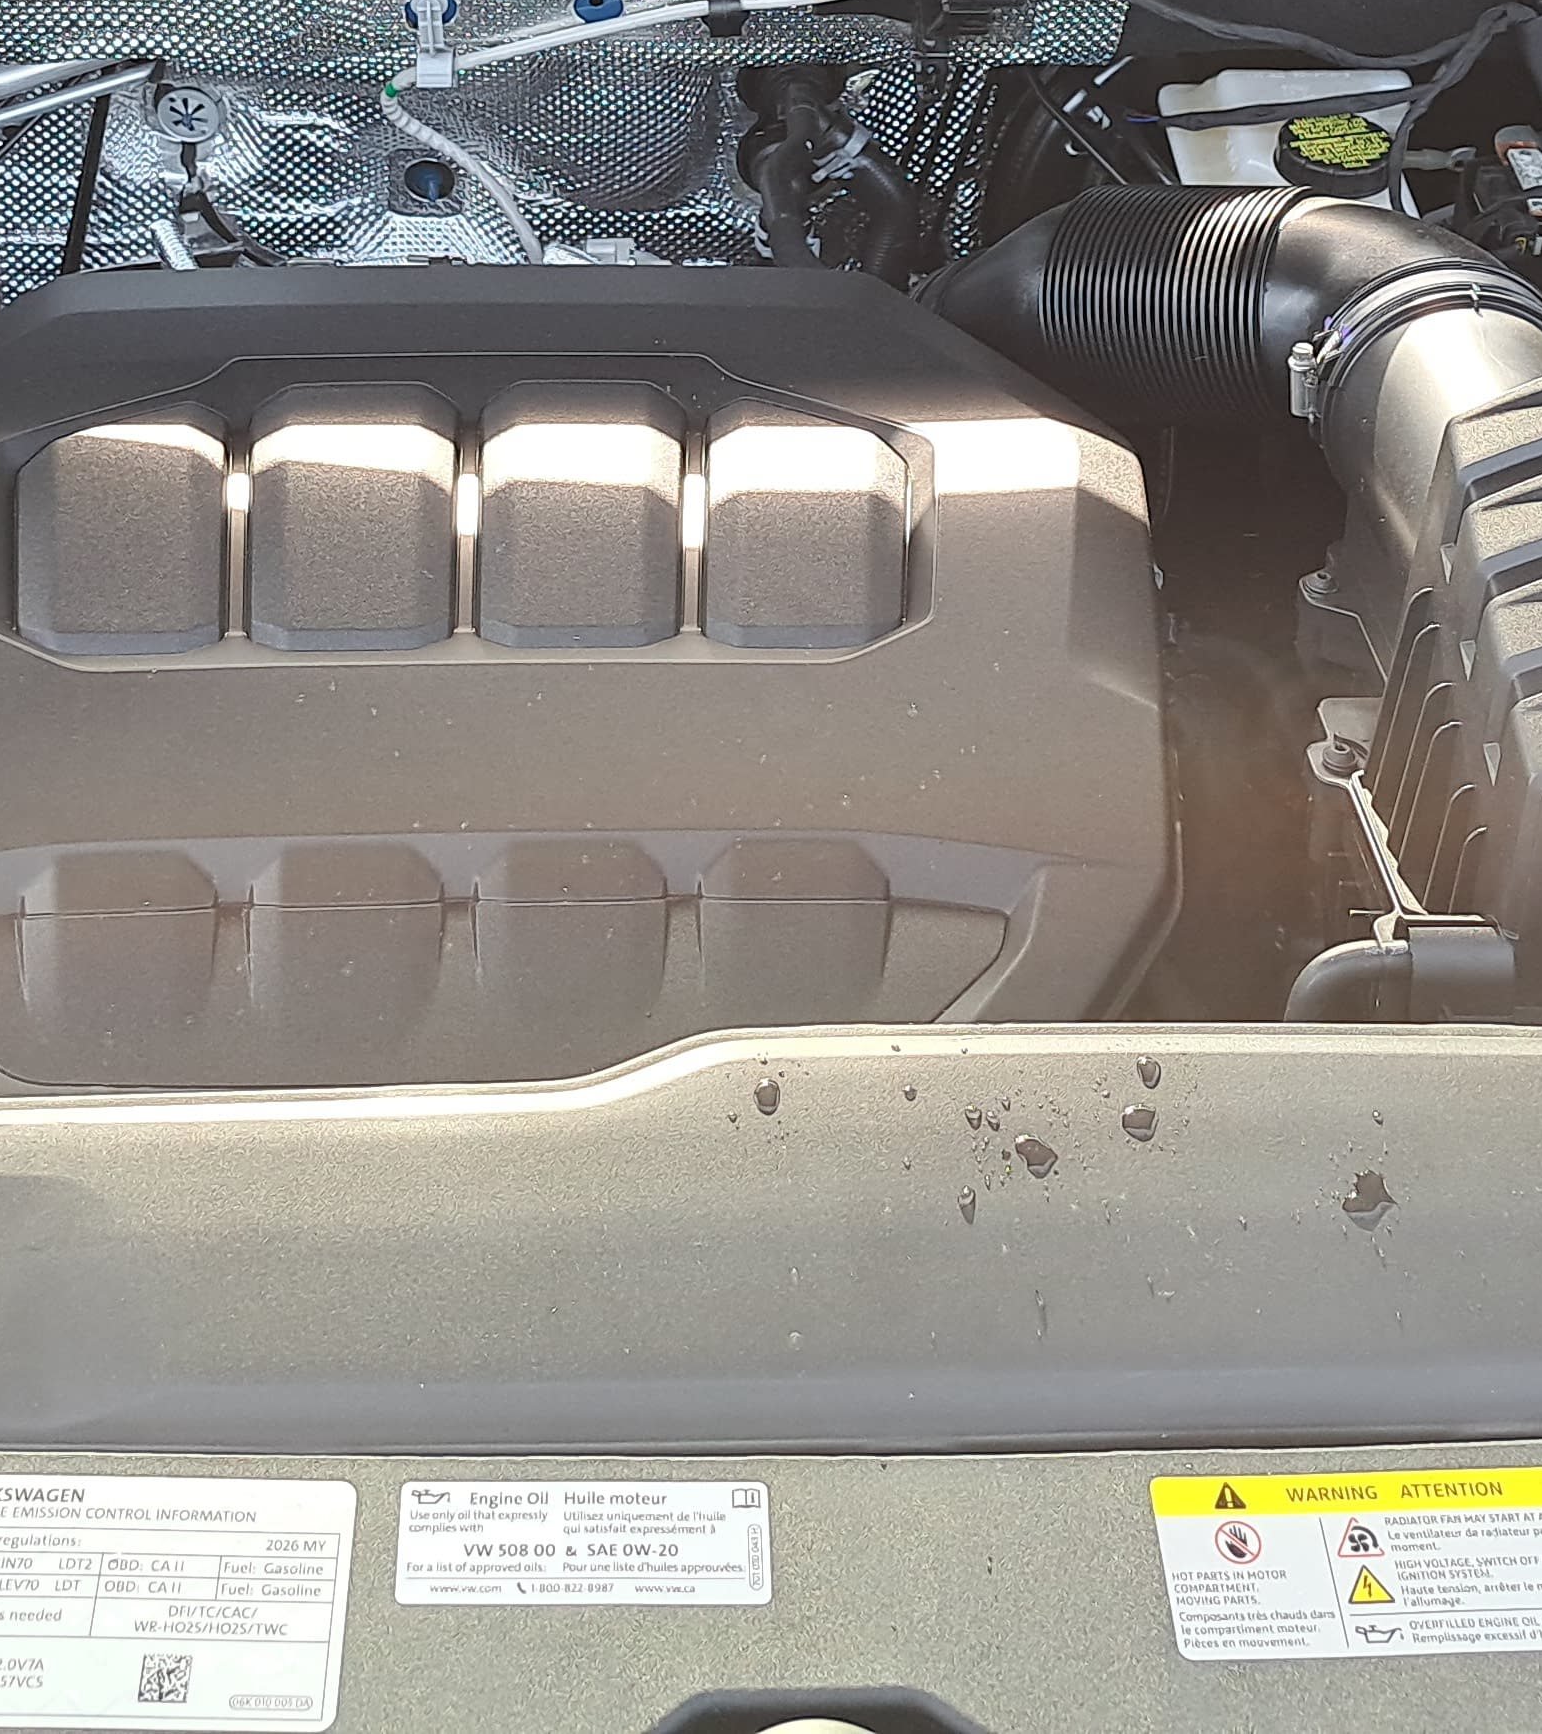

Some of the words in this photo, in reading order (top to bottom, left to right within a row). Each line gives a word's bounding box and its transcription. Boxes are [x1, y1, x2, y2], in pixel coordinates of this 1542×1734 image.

[1286, 1486, 1378, 1502] WARNING
[1401, 1481, 1502, 1498] ATTENTION
[470, 1492, 522, 1509] Engine
[527, 1492, 548, 1505] Oil
[564, 1492, 605, 1505] Huile
[610, 1492, 667, 1505] moteur
[12, 1507, 82, 1518] EMISSION
[85, 1507, 151, 1520] CONTROL
[156, 1508, 257, 1523] INFORMATION
[410, 1510, 430, 1520] Use
[432, 1510, 455, 1522] only
[458, 1510, 470, 1520] oil
[473, 1511, 495, 1520] that
[498, 1511, 548, 1522] expressly
[564, 1512, 603, 1521] Utilisez
[607, 1512, 673, 1524] uniquement
[677, 1512, 690, 1521] de
[1385, 1515, 1437, 1525] RADIATOR
[1440, 1515, 1461, 1524] FAN
[1465, 1514, 1486, 1523] MAY
[1490, 1513, 1520, 1522] START
[1524, 1513, 1535, 1522] AT
[409, 1523, 456, 1534] complies
[460, 1523, 483, 1532] with
[563, 1524, 580, 1535] qui
[584, 1524, 626, 1534] satisfait
[630, 1524, 705, 1536] expressément
[1388, 1530, 1400, 1540] Le
[1403, 1530, 1461, 1539] ventilateur
[1482, 1527, 1529, 1537] radiateur
[266, 1540, 299, 1551] 2026
[303, 1540, 326, 1551] MY
[464, 1544, 493, 1556] VW
[499, 1544, 528, 1557] 508
[534, 1544, 555, 1557] 00
[566, 1545, 577, 1556] &
[587, 1544, 617, 1556] SAE
[623, 1544, 678, 1556] 0W-20
[1391, 1542, 1441, 1552] moment.
[59, 1558, 92, 1570] LDT2
[108, 1559, 143, 1571] OBD:
[151, 1560, 171, 1571] CA
[224, 1562, 256, 1574] Fuel:
[264, 1563, 323, 1575] Gasoline
[407, 1562, 423, 1572] For
[437, 1563, 452, 1572] list
[455, 1562, 466, 1572] of
[470, 1563, 521, 1574] approved
[563, 1562, 586, 1572] Pour
[590, 1564, 609, 1572] une
[613, 1562, 635, 1571] liste
[638, 1562, 678, 1571] d'huiles
[1395, 1560, 1421, 1569] HIGH
[1476, 1557, 1517, 1566] SWITCH
[1520, 1556, 1539, 1565] OFF
[1172, 1572, 1194, 1581] HOT
[1197, 1571, 1230, 1580] PARTS
[1234, 1571, 1244, 1580] IN
[1248, 1570, 1287, 1580] MOTOR
[1398, 1570, 1446, 1581] IGNITION
[55, 1580, 81, 1592] LDT
[104, 1581, 139, 1593] OBD:
[148, 1582, 167, 1594] CA
[221, 1584, 253, 1596] Fuel:
[262, 1585, 321, 1597] Gasoline
[1401, 1584, 1434, 1595] Haute
[1484, 1582, 1520, 1592] arrêter
[1524, 1582, 1533, 1591] le
[1177, 1597, 1220, 1605] MOVING
[9, 1609, 62, 1621] needed
[1179, 1611, 1245, 1623] Composants
[1248, 1610, 1268, 1620] très
[1271, 1610, 1307, 1620] chauds
[1310, 1610, 1335, 1619] dans
[1409, 1619, 1475, 1630] OVERFILLED
[1479, 1617, 1518, 1628] ENGINE
[1522, 1616, 1540, 1627] OIL
[1182, 1625, 1191, 1635] le
[1195, 1624, 1273, 1636] compartiment
[1184, 1638, 1219, 1648] Pièces
[1223, 1639, 1235, 1647] en
[1412, 1632, 1481, 1644] Remplissage
[1485, 1630, 1526, 1640] excessif
